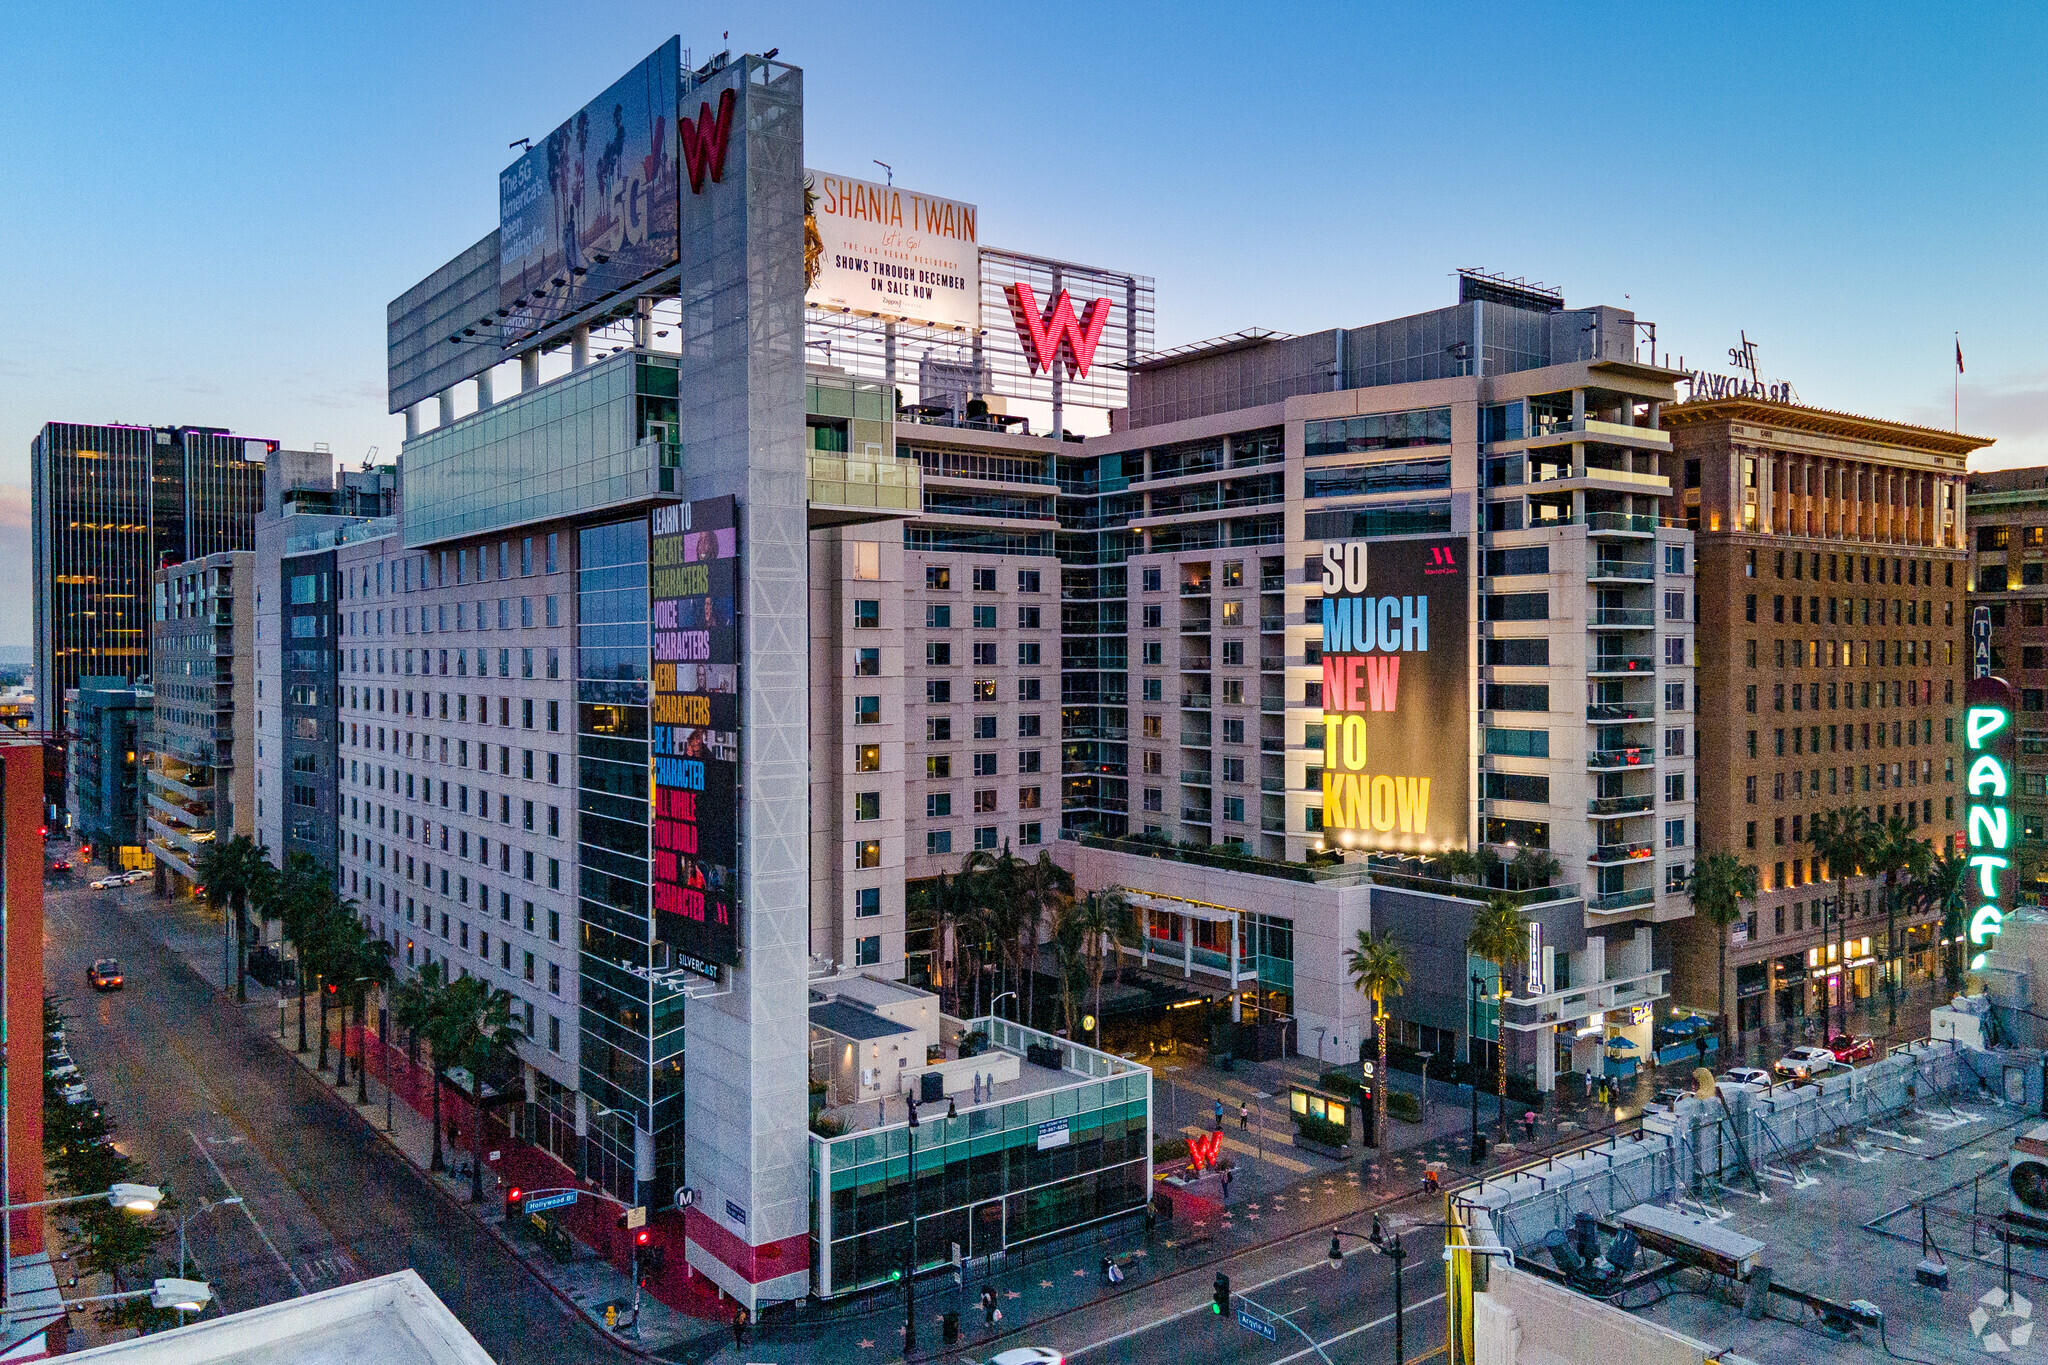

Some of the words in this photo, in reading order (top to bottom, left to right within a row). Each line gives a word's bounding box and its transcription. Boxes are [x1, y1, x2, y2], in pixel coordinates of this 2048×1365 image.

[678, 87, 735, 195] W
[501, 172, 517, 198] The
[518, 159, 532, 182] 5G
[502, 175, 543, 218] America's
[611, 162, 650, 252] 5G
[824, 176, 903, 228] SHANIA
[910, 196, 975, 243] TWAIN
[501, 216, 523, 242] been
[502, 230, 531, 266] waiting
[843, 241, 858, 251] THE
[864, 246, 878, 255] LAS
[884, 249, 909, 260] VEGAS
[915, 255, 958, 270] RESIDENCY
[836, 254, 869, 273] SHOWS
[873, 261, 915, 281] THROUGH
[919, 271, 965, 290] DECEMBER
[871, 278, 883, 291] ON
[887, 280, 909, 296] SALE
[913, 285, 932, 300] NOW
[1003, 282, 1112, 382] W
[653, 504, 679, 535] LEARN
[680, 501, 692, 531] TO
[653, 535, 684, 567] CREATE
[1323, 541, 1368, 594] SO
[653, 564, 709, 598] CHARACTERS
[654, 600, 678, 629] VOICE
[1322, 595, 1428, 652] MUCH
[654, 630, 709, 660] CHARACTERS
[654, 663, 676, 692] KERN
[1323, 656, 1400, 712] NEW
[654, 695, 710, 726] CHARACTERS
[654, 726, 665, 754] BE
[666, 728, 673, 755] A
[1323, 714, 1367, 771] TO
[655, 757, 705, 791] CHARACTER
[670, 790, 696, 822] WHILE
[1323, 772, 1430, 834] KNOW
[655, 819, 671, 849] YOU
[672, 821, 697, 854] BUILD
[1967, 708, 2008, 970] PANTA
[655, 850, 677, 882] YOUR
[655, 881, 704, 922] CHARACTER
[678, 953, 718, 978] SILVERCAST
[1185, 1131, 1224, 1170] W
[529, 1197, 565, 1210] Hollywood
[680, 1190, 693, 1205] M
[1242, 1315, 1262, 1331] Argyle
[1264, 1326, 1272, 1335] Av
